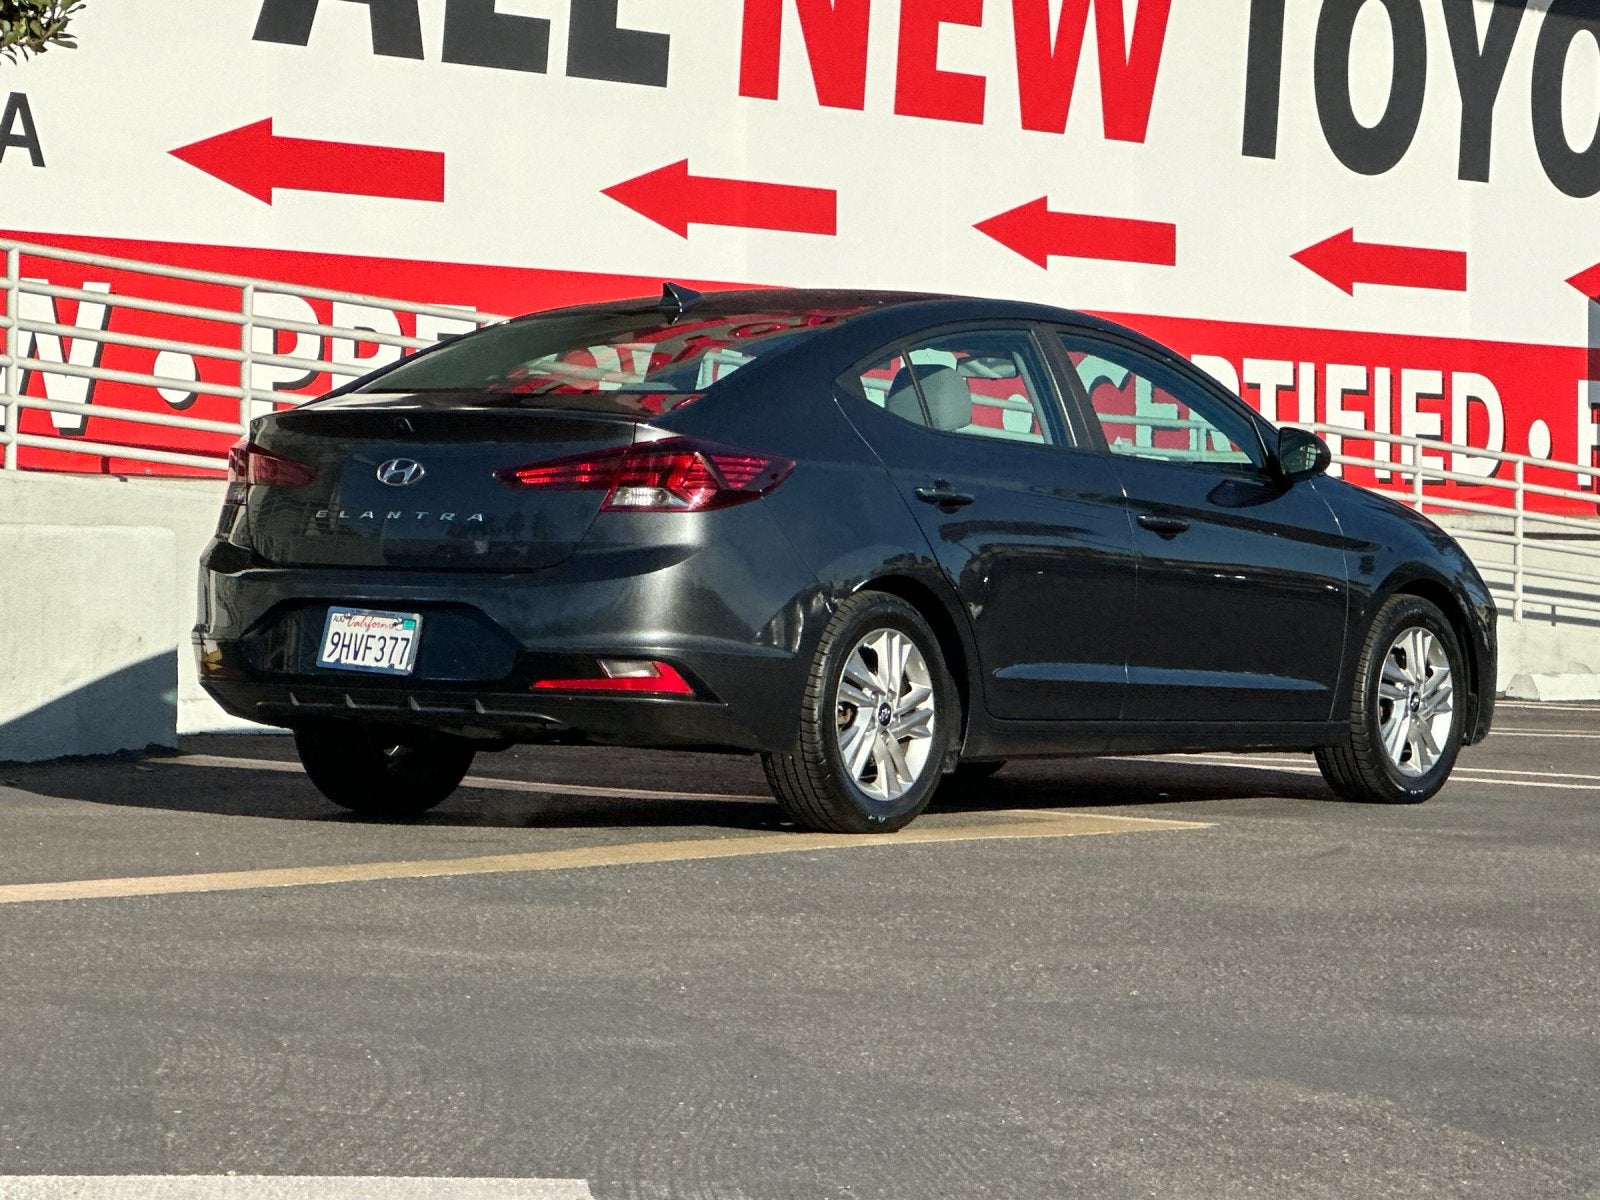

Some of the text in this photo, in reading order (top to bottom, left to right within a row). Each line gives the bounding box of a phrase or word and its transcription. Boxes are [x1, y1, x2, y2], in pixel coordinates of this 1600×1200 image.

[0, 92, 46, 168] A
[315, 509, 483, 522] ELANTRA
[327, 631, 410, 665] 9HVF377
